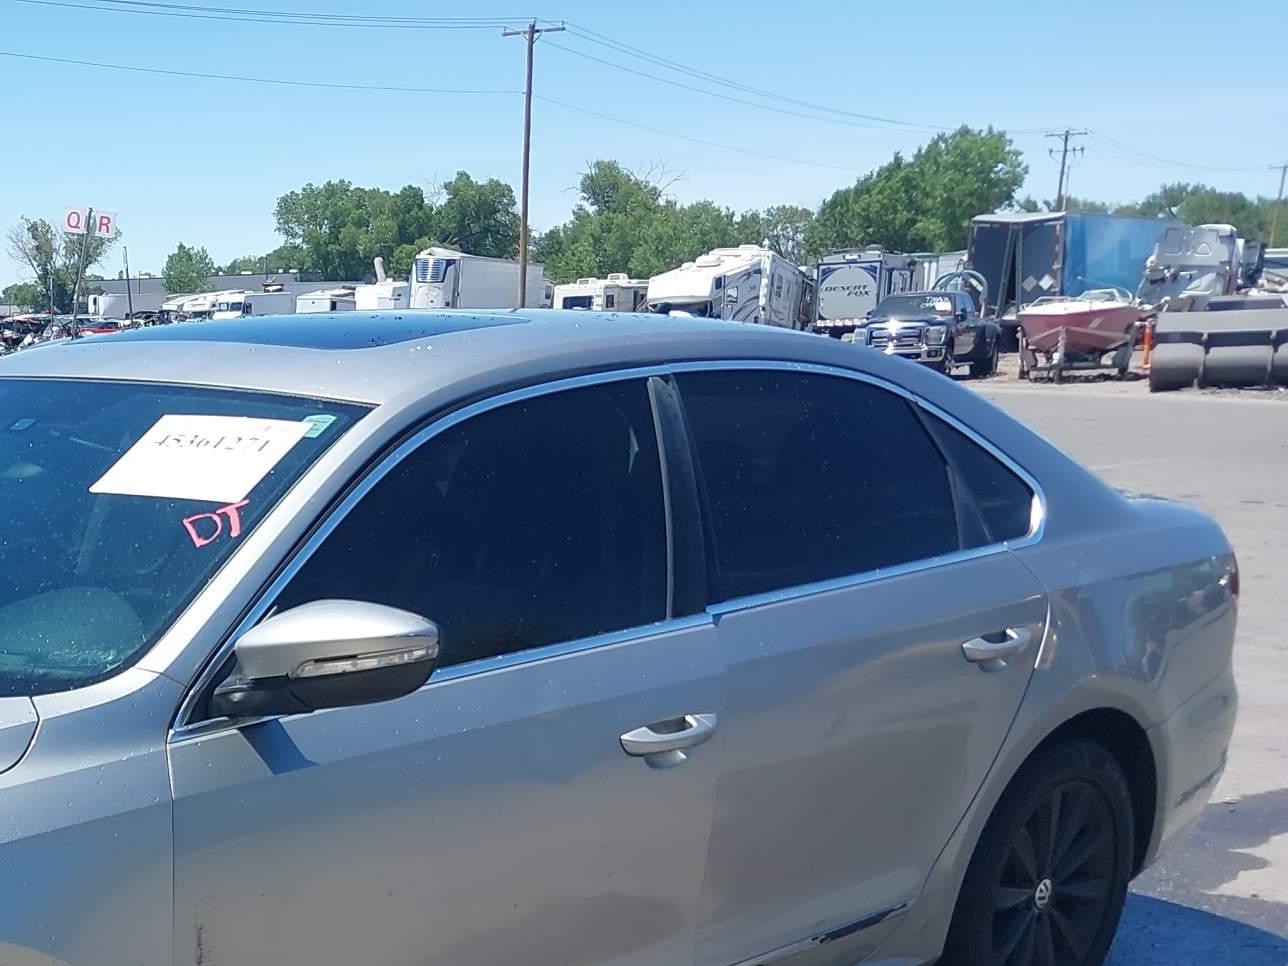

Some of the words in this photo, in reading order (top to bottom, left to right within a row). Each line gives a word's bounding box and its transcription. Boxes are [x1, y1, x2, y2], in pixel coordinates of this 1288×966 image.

[67, 211, 81, 229] Q
[98, 215, 111, 233] R
[824, 284, 869, 292] DESERT
[183, 499, 249, 547] DT
